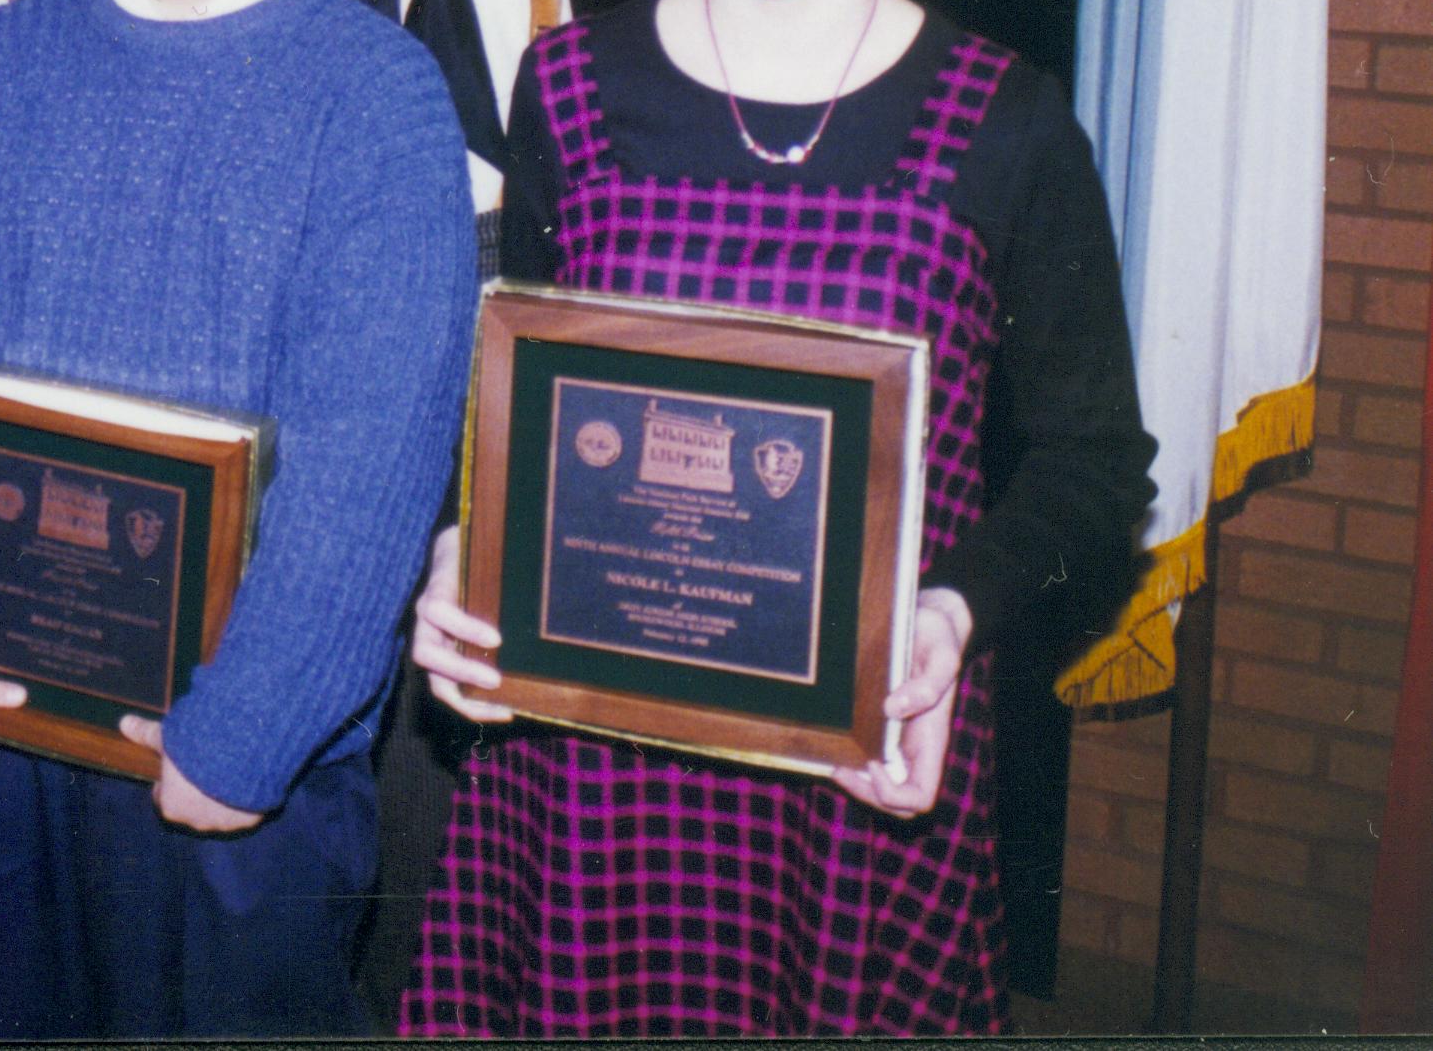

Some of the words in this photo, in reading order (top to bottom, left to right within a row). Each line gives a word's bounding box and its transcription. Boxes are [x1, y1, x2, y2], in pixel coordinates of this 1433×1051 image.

[726, 560, 802, 583] COMPETITION
[606, 570, 660, 590] NICOLE
[663, 579, 675, 594] L.
[679, 583, 753, 606] KAUFMAN
